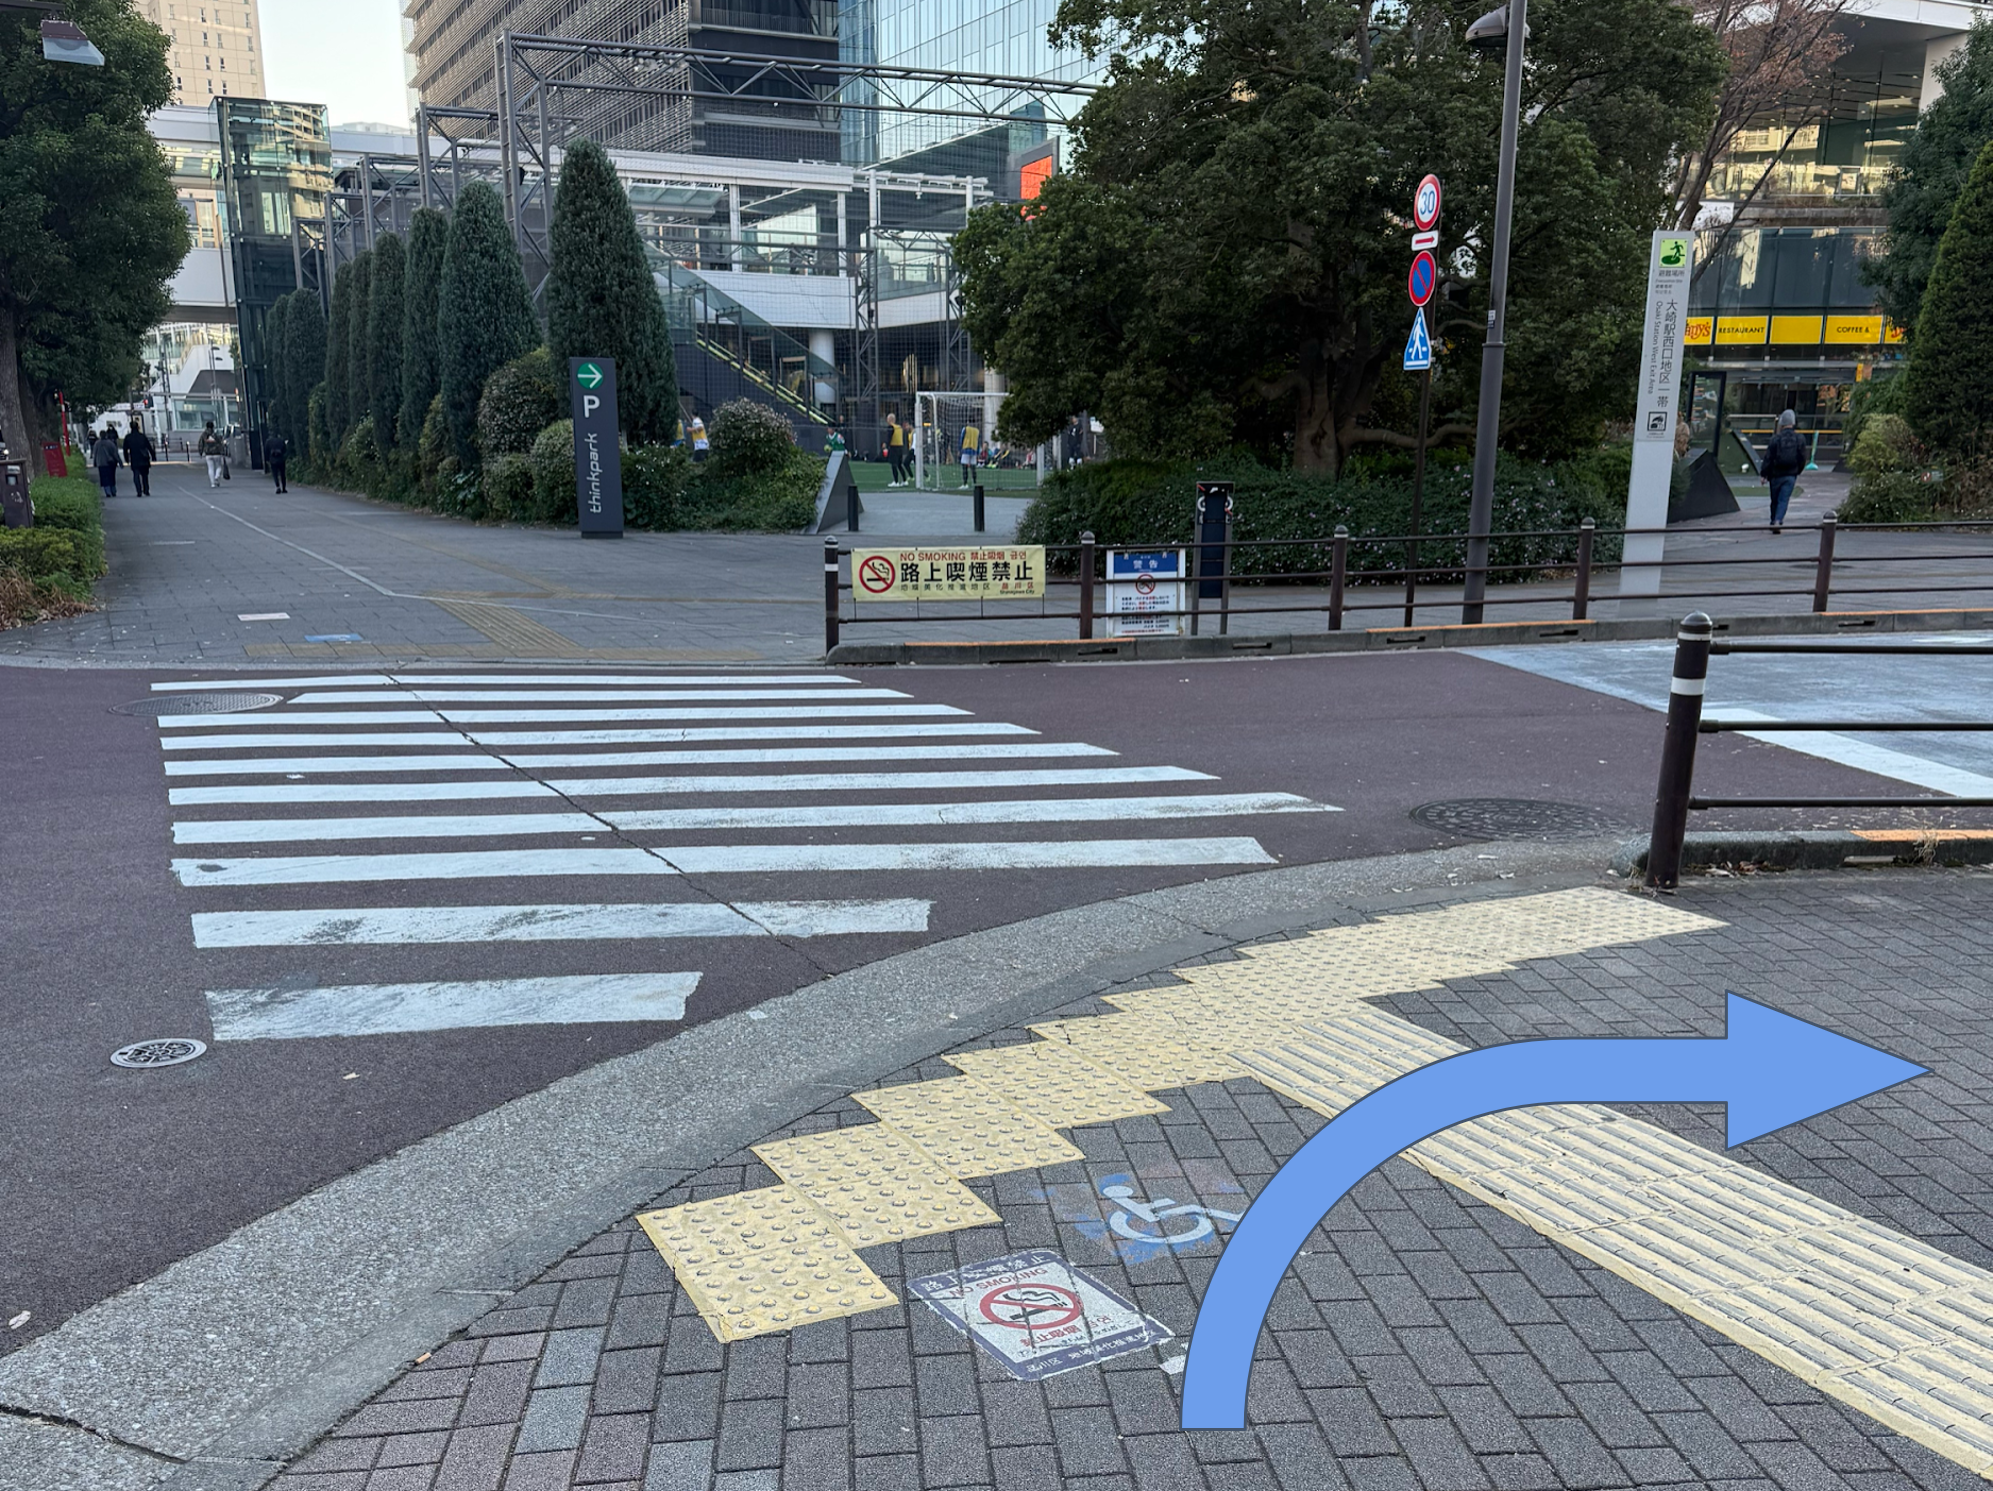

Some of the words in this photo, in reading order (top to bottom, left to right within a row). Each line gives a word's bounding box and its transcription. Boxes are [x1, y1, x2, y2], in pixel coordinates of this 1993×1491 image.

[1420, 190, 1435, 215] 30
[1655, 301, 1664, 320] Osaki
[1653, 321, 1661, 346] Station
[1718, 326, 1765, 334] RESTAURANT
[1651, 346, 1659, 363] West
[1657, 299, 1678, 408] 大崎駅西口地区一帯
[1649, 365, 1657, 377] Exit
[1648, 379, 1656, 395] Area
[583, 395, 601, 418] P
[584, 432, 603, 514] thinkpark
[900, 552, 915, 561] NO
[918, 552, 966, 561] SMOKING
[970, 551, 1005, 560] 禁止吸烟
[1010, 551, 1027, 560] 금연
[900, 561, 1033, 583] 路上喫煙禁止
[949, 1286, 974, 1299] NO
[975, 1267, 1048, 1290] SMOKING
